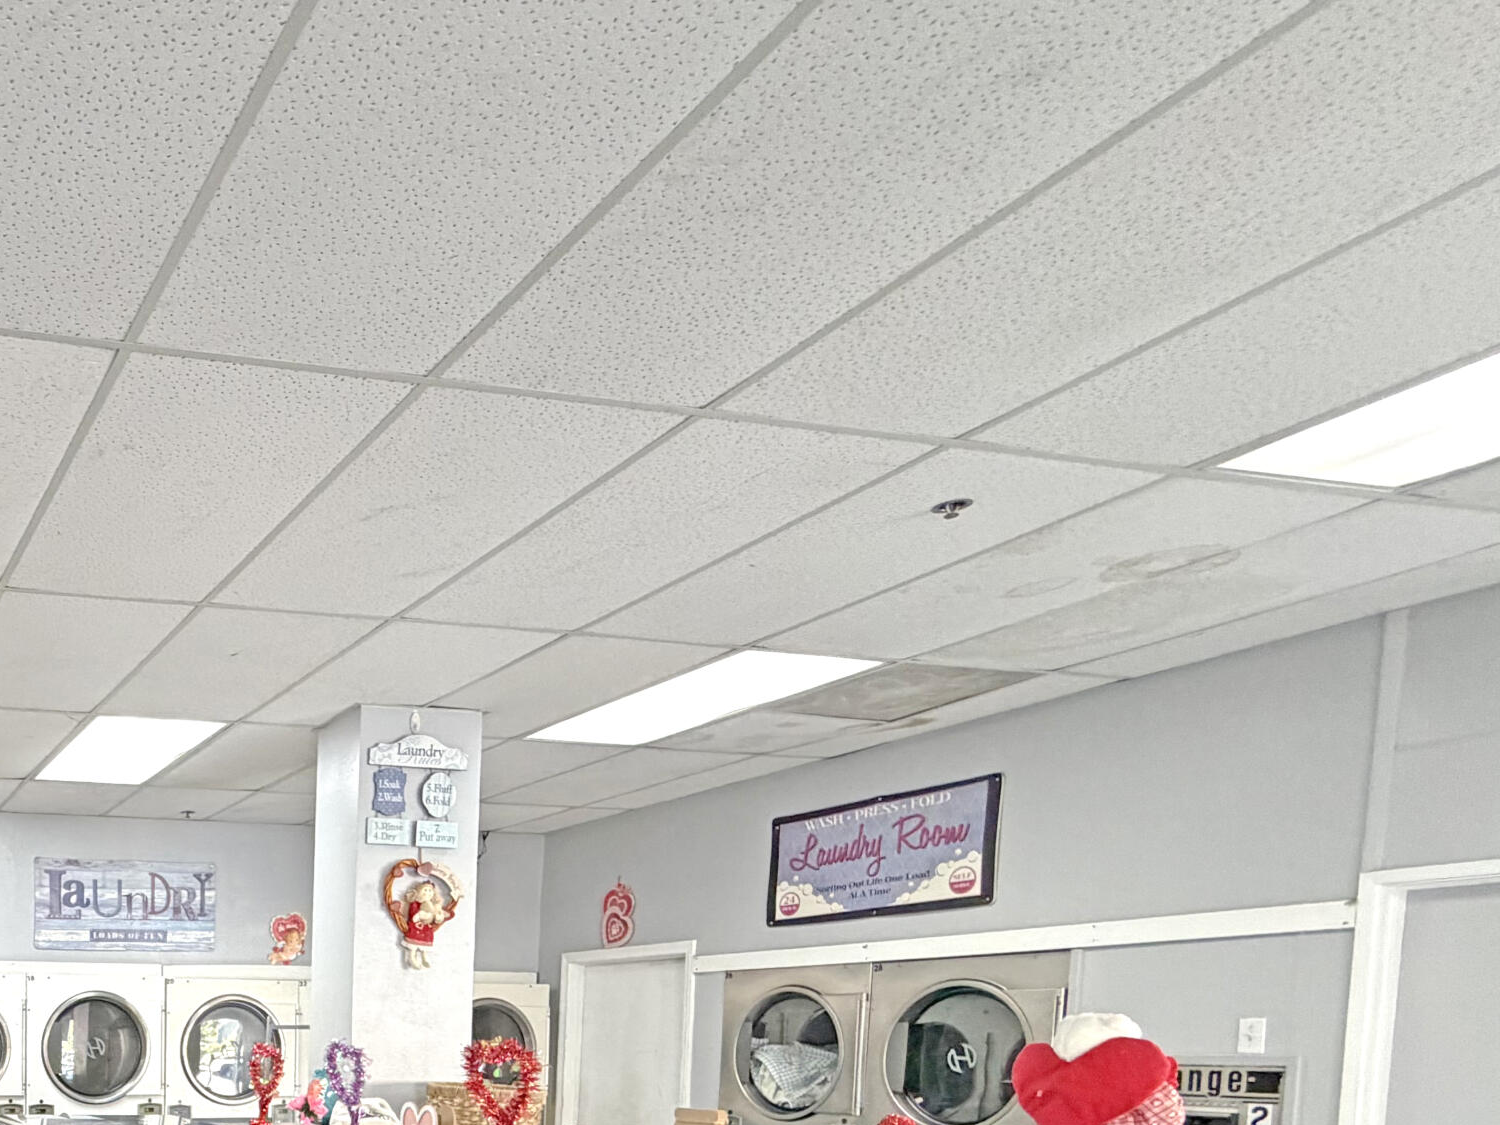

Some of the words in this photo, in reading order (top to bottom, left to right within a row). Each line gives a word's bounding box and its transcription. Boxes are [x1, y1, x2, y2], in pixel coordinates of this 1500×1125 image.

[397, 742, 445, 758] Laundry
[804, 813, 844, 831] WASH
[854, 802, 900, 821] PRESS
[909, 791, 952, 809] FOLD
[419, 831, 433, 842] Put
[435, 833, 456, 844] away
[789, 823, 887, 877] Laundry
[891, 813, 971, 854] Room
